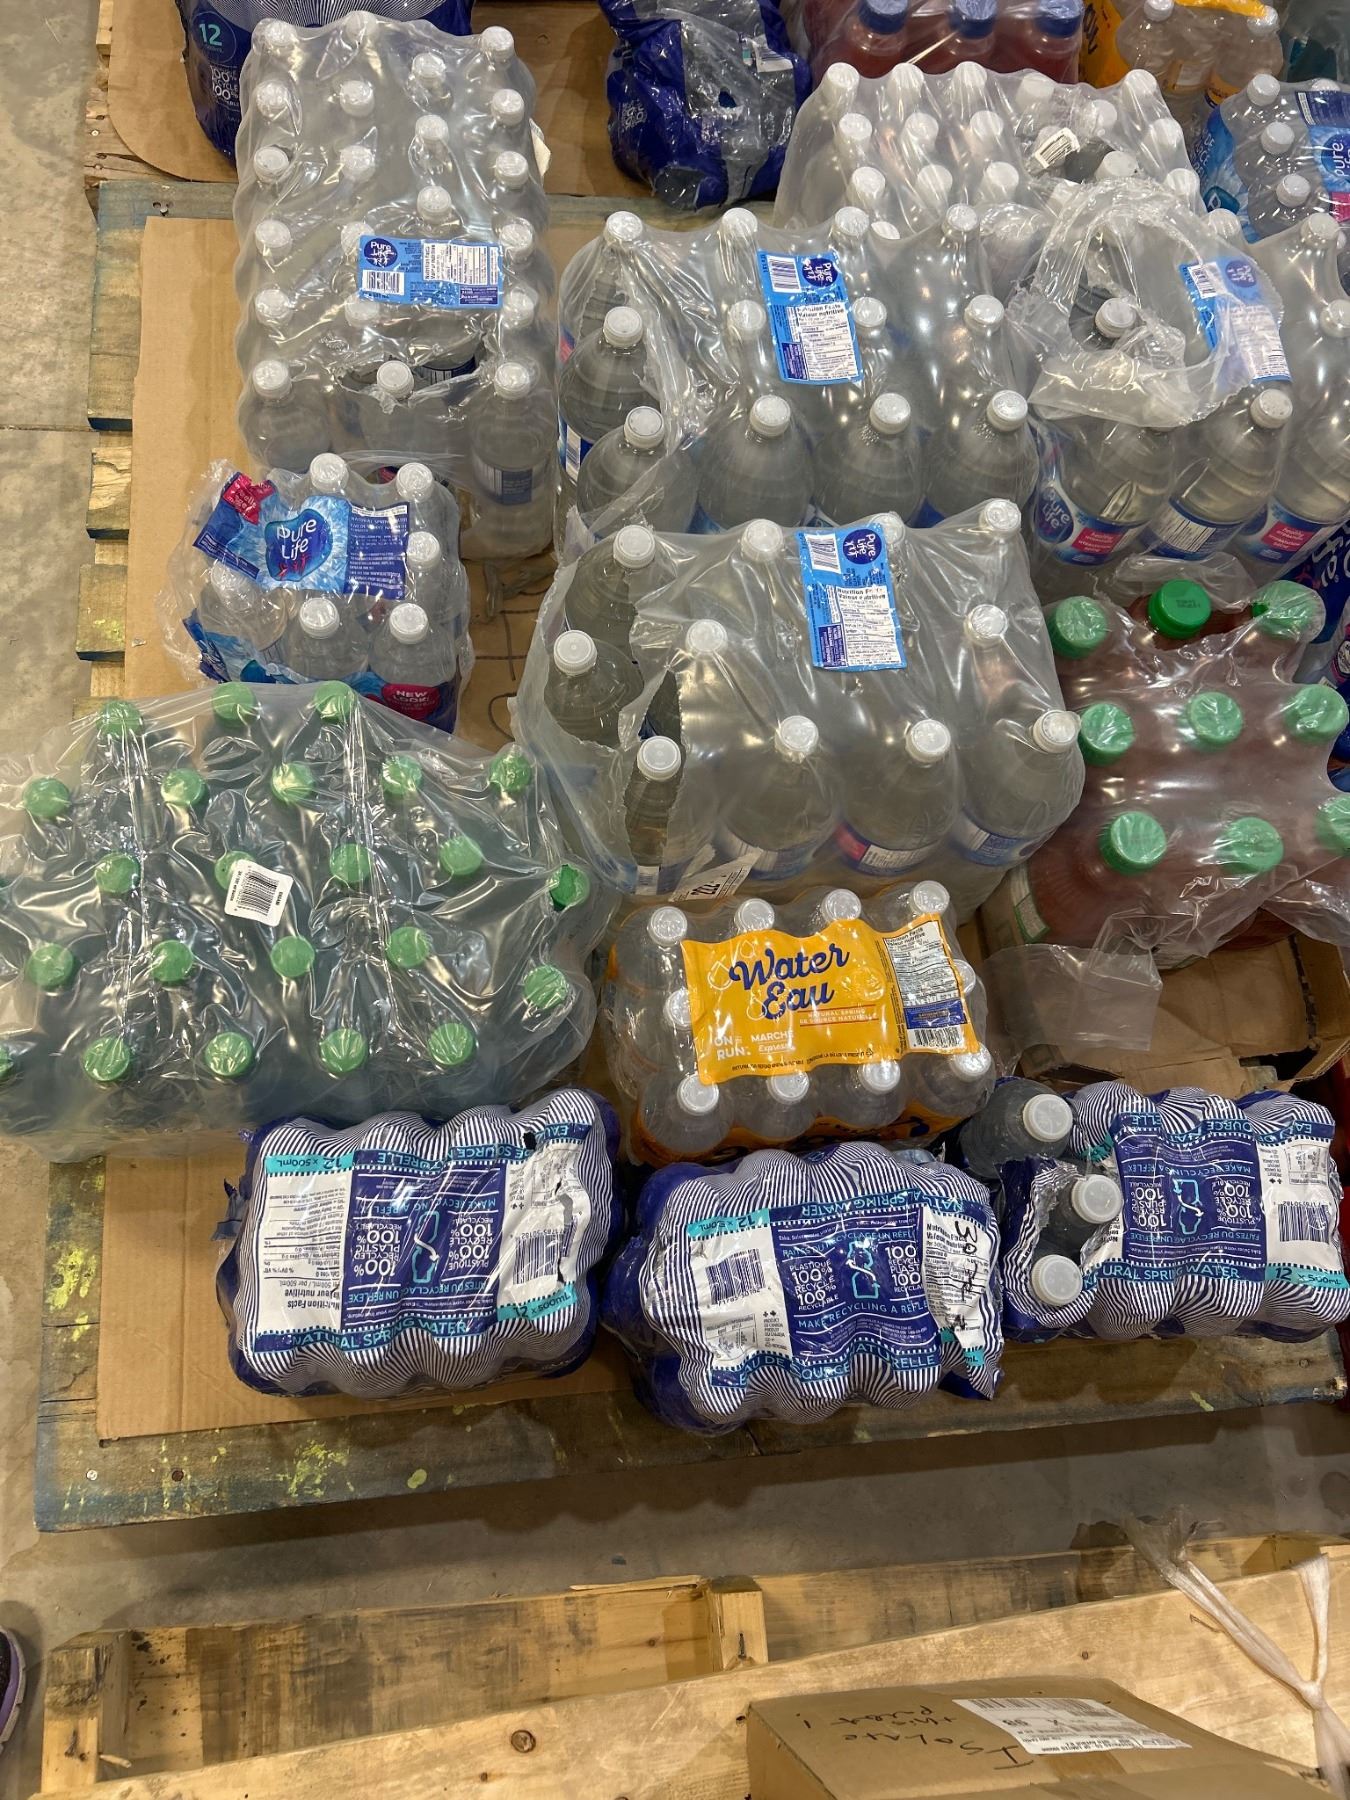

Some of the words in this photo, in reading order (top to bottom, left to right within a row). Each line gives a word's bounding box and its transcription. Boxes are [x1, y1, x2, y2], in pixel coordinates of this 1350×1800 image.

[199, 23, 222, 46] 12
[281, 539, 310, 561] Life
[867, 533, 877, 557] Pure
[396, 690, 428, 698] NEW
[729, 943, 849, 991] Water
[762, 980, 837, 1020] Eau
[714, 1035, 733, 1047] ON
[717, 1046, 746, 1061] RUN
[1206, 1121, 1251, 1131] OURCE
[276, 1159, 311, 1167] 500mL
[323, 1157, 342, 1170] 12
[1224, 1164, 1251, 1173] MAKE
[1130, 1187, 1165, 1200] 100%
[1213, 1185, 1251, 1197] 100%
[853, 1194, 905, 1209] SPRING
[802, 1202, 851, 1217] WATER
[1216, 1204, 1254, 1218] 100%
[737, 1216, 755, 1228] 12
[1132, 1215, 1167, 1227] 100%
[356, 1230, 400, 1245] 100%
[451, 1223, 493, 1238] 100%
[1221, 1231, 1234, 1239] DU
[1235, 1232, 1260, 1241] FAITES
[355, 1244, 400, 1252] PLASTIC
[448, 1244, 490, 1260] 100%
[884, 1244, 917, 1259] 100
[354, 1251, 399, 1260] RECYCLED
[354, 1259, 397, 1278] 100%
[448, 1260, 489, 1271] PLASTIQUE
[789, 1260, 831, 1272] PLASTIQUE
[1187, 1264, 1239, 1278] WATER
[1275, 1267, 1292, 1278] 12
[791, 1266, 833, 1285] 100%
[891, 1272, 921, 1287] 100
[284, 1289, 315, 1298] nutritive
[385, 1290, 399, 1300] UN
[797, 1285, 836, 1305] 100%
[287, 1300, 306, 1309] Facts
[513, 1305, 528, 1319] 12
[537, 1292, 569, 1311] 500mL
[798, 1315, 830, 1328] MAKE
[829, 1302, 887, 1322] RECYCLING
[890, 1305, 899, 1314] A
[419, 1317, 468, 1334] WATER
[765, 1355, 786, 1365] DE
[798, 1361, 849, 1380] OURCE
[851, 1342, 936, 1369] ATURELLE
